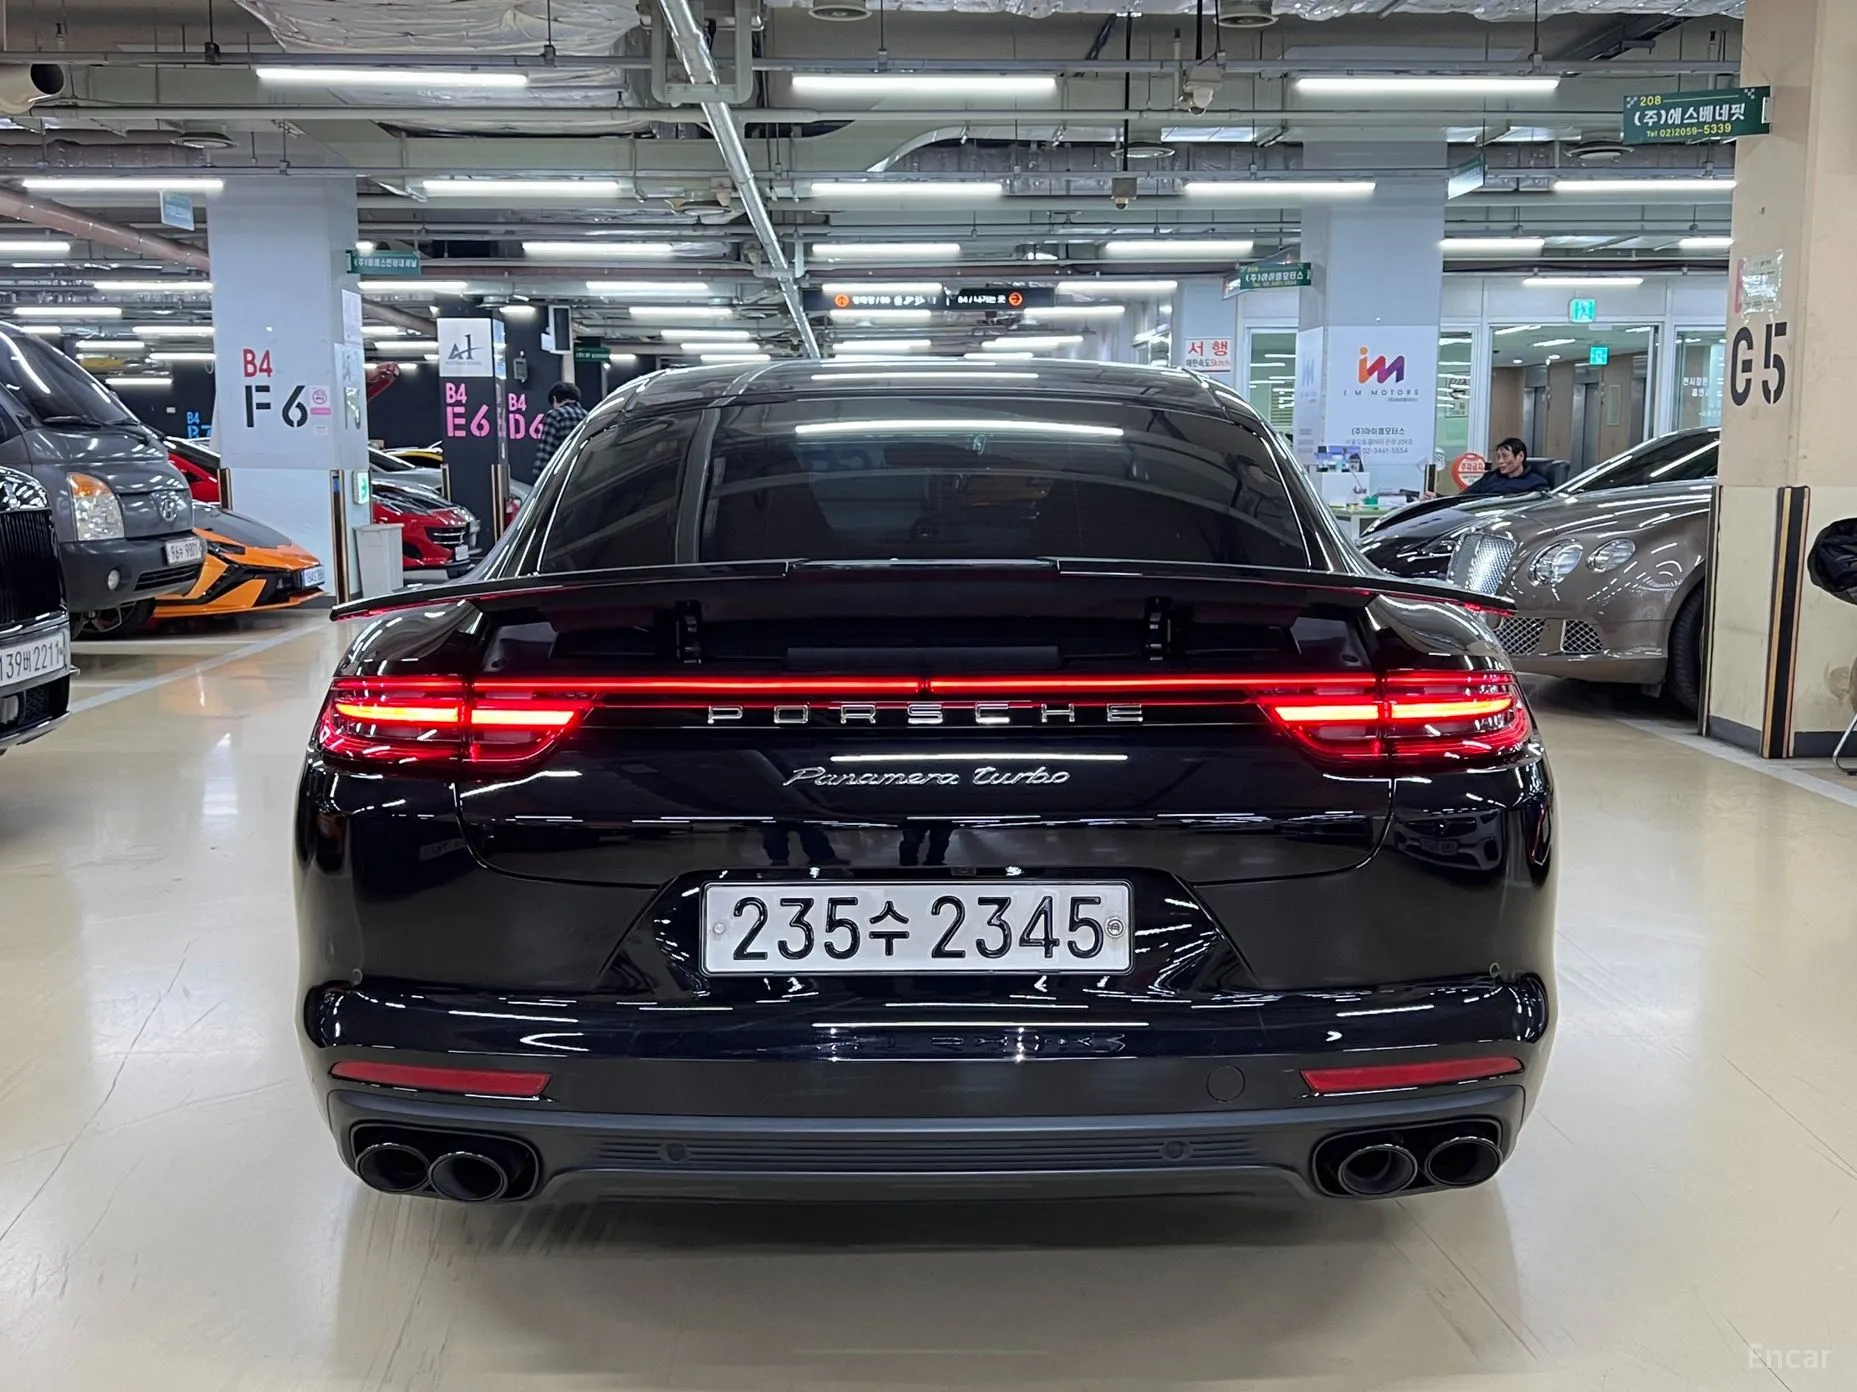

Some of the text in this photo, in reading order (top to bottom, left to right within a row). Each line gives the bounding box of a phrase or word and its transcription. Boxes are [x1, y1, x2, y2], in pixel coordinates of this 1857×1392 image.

[1639, 95, 1662, 107] 208
[1633, 102, 1746, 127] (주)에스베네핏
[1659, 123, 1732, 138] 02)2059-5339
[1187, 340, 1228, 357] 서행
[242, 348, 274, 378] B4
[445, 382, 468, 404] B4
[508, 392, 527, 412] B4
[186, 411, 200, 424] B4
[446, 404, 490, 437] E6
[508, 413, 545, 439] D6
[707, 702, 1145, 725] PORSCHE
[782, 764, 1071, 788] Panamera turbo
[732, 895, 1106, 961] 235수 2345
